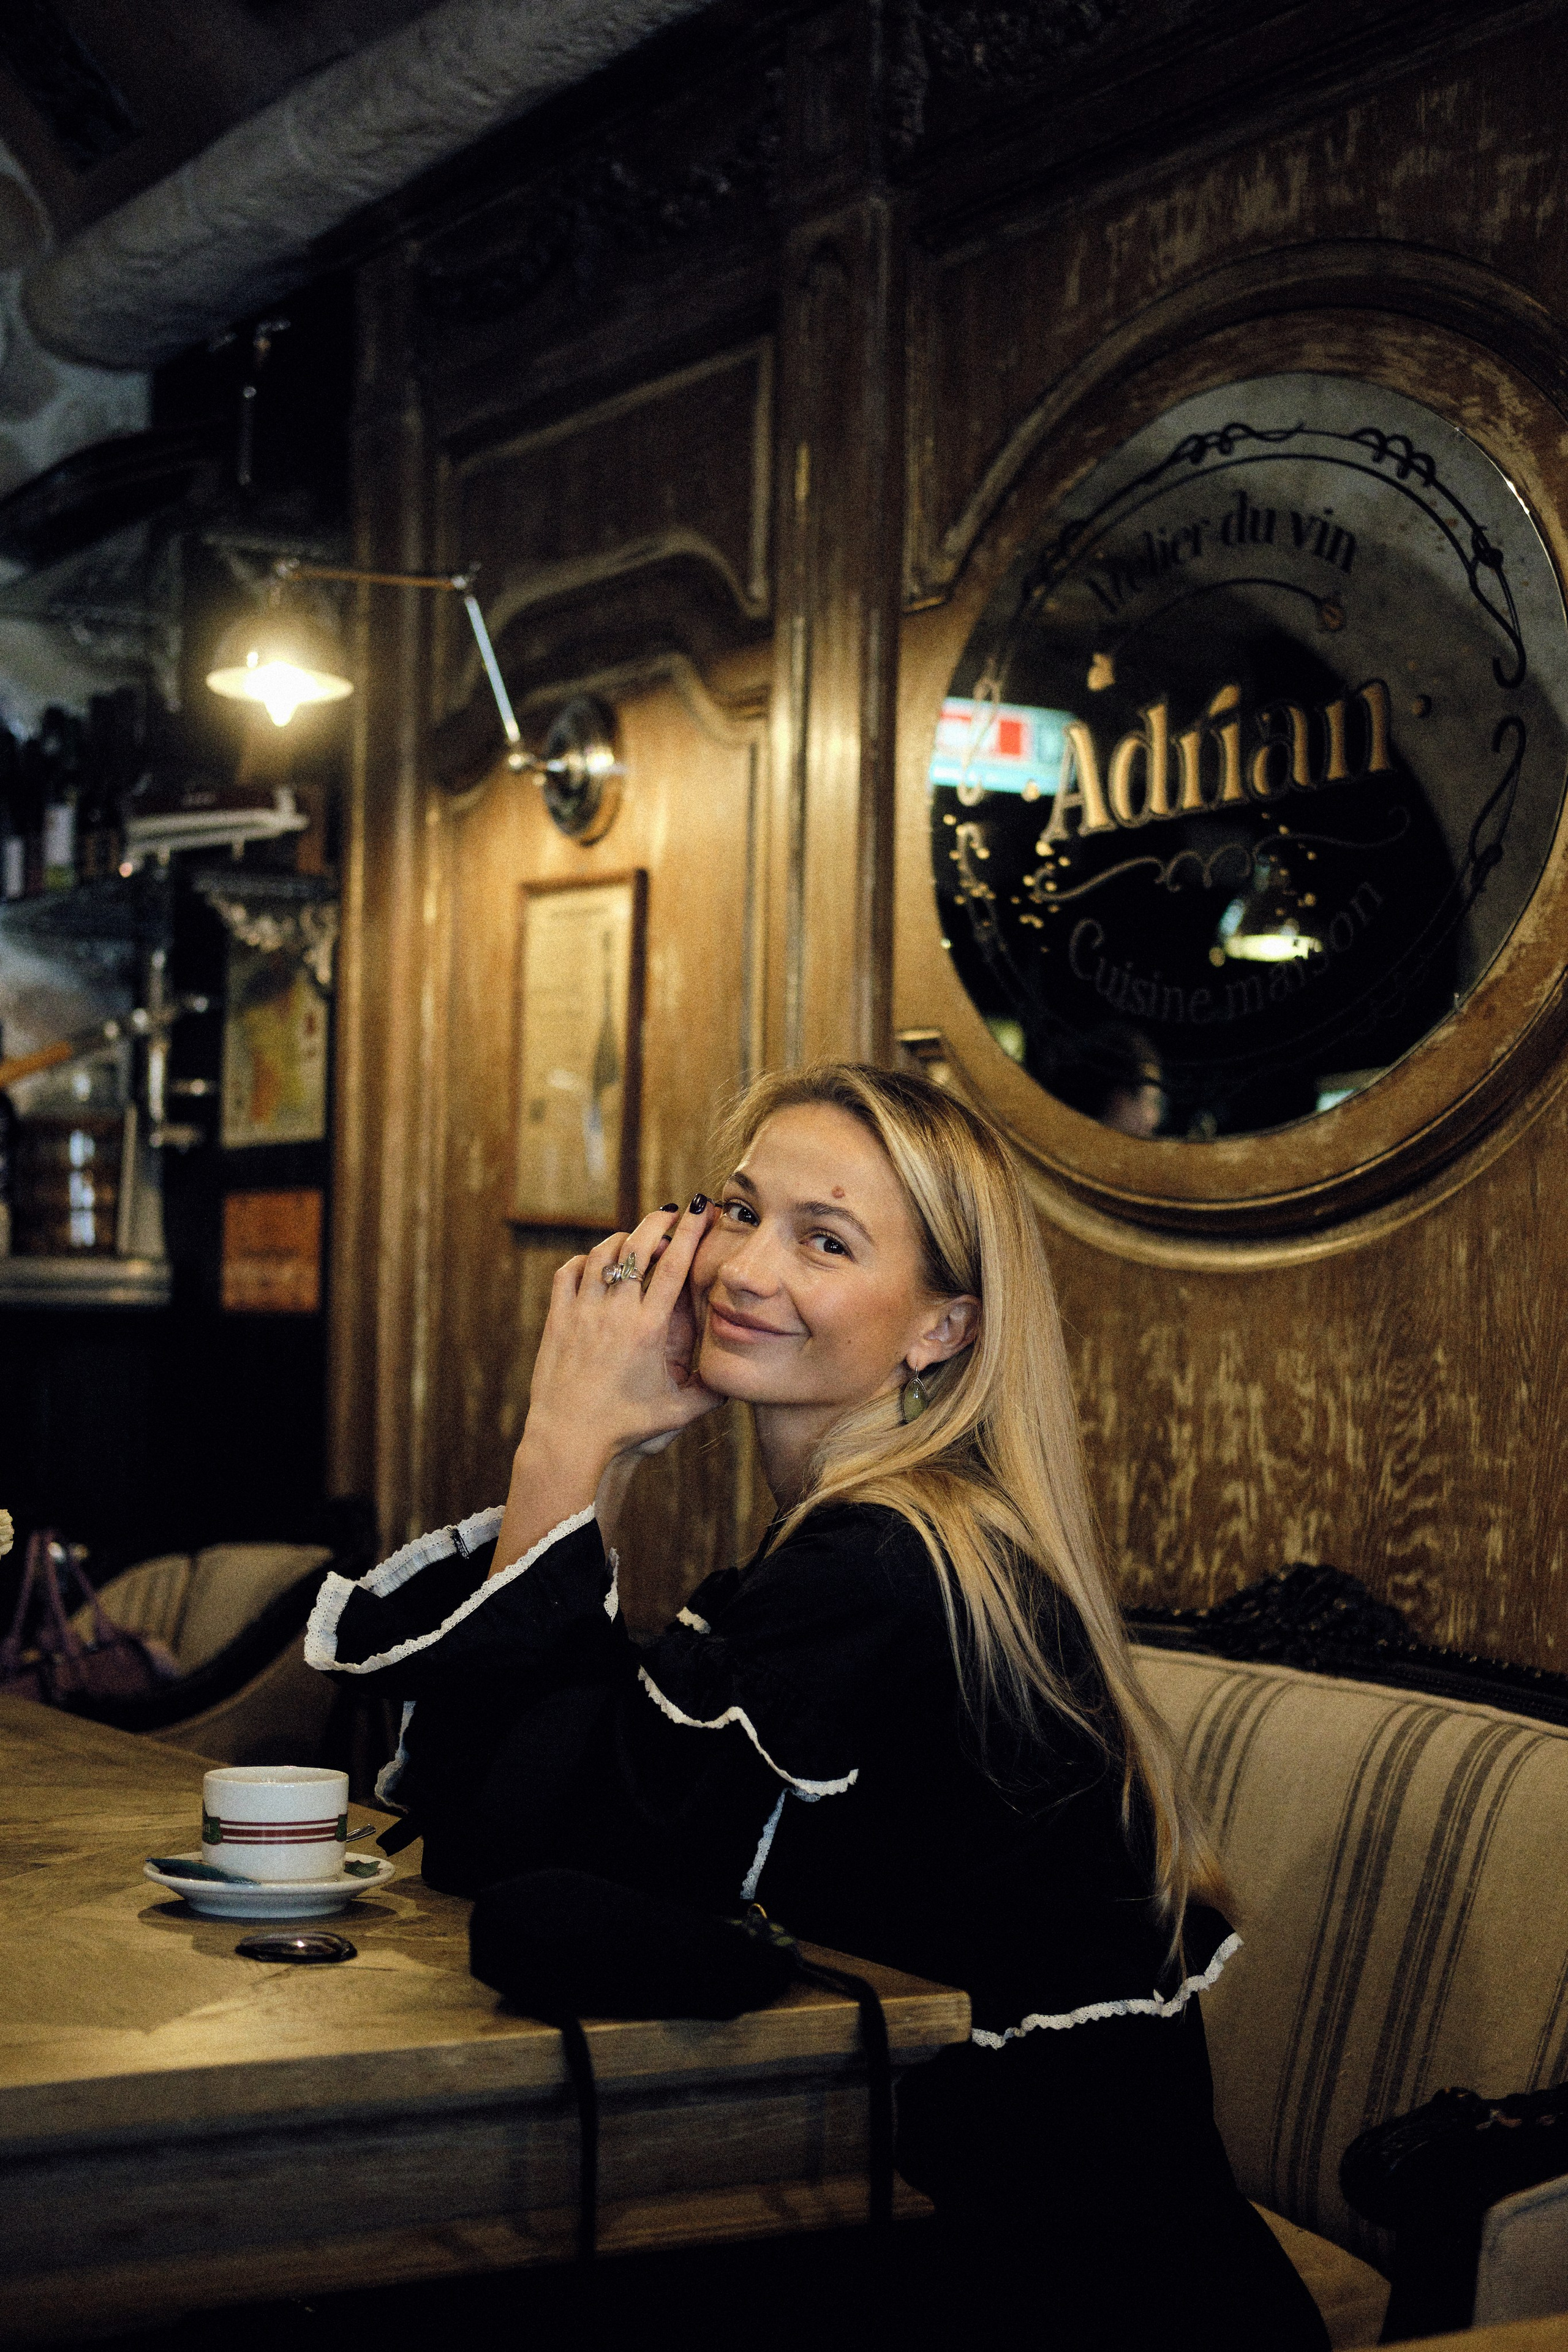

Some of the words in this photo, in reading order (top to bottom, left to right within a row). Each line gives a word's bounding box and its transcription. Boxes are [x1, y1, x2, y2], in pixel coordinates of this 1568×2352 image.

[1221, 490, 1276, 546] du
[1290, 508, 1357, 574] vin
[1041, 680, 1398, 843] Adrían
[1069, 917, 1212, 1025] Cuisine
